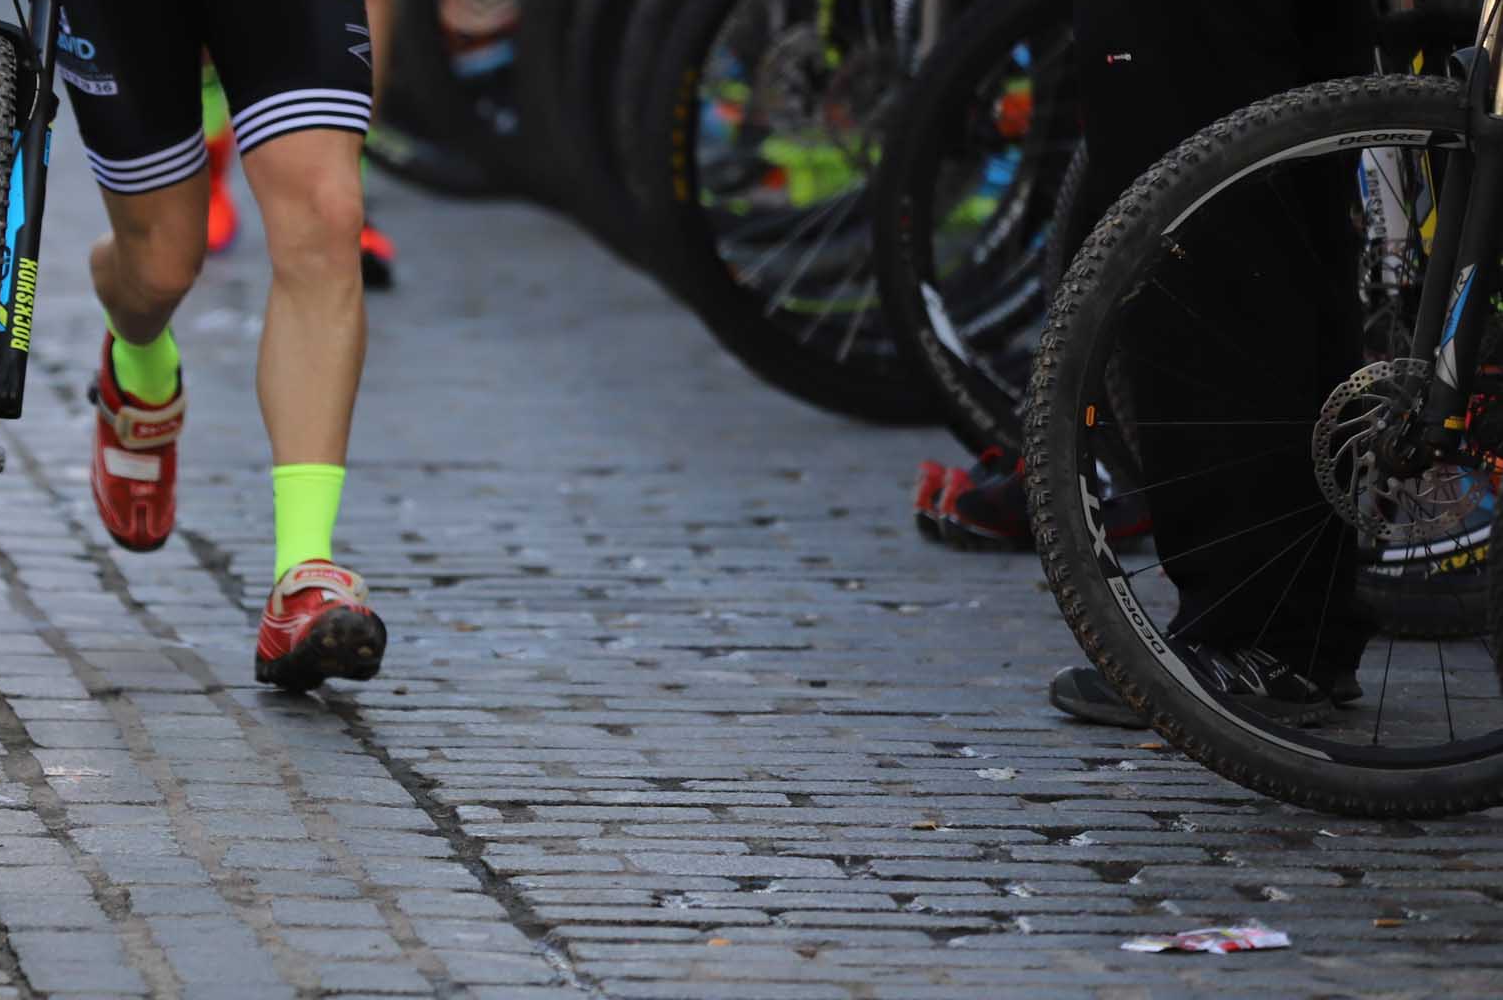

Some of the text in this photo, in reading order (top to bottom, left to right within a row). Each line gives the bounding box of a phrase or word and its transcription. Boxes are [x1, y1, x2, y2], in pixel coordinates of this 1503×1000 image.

[1338, 132, 1426, 146] DEORE
[10, 257, 38, 353] ROCKSHOX
[1114, 582, 1166, 655] DEORE
